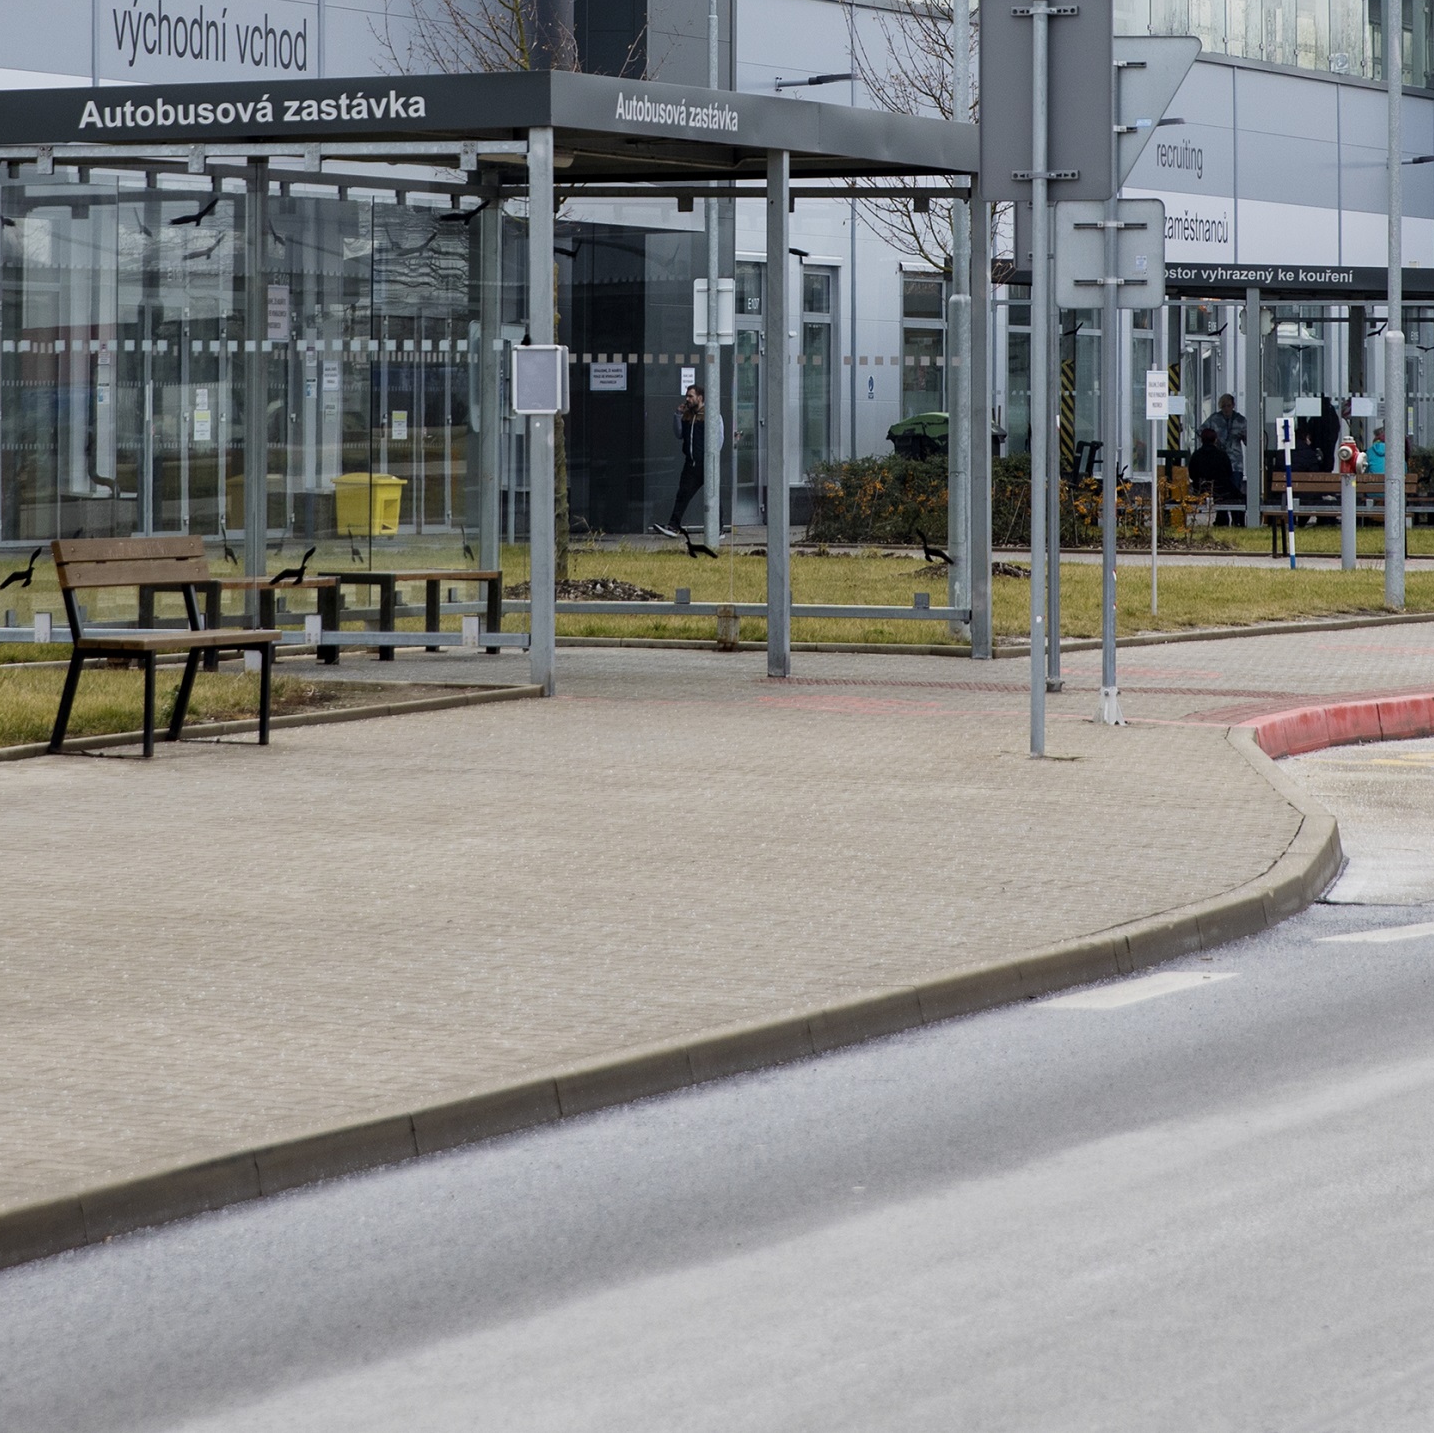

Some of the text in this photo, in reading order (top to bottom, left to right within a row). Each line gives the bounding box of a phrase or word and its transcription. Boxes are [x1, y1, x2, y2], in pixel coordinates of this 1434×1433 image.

[235, 13, 308, 72] vchod
[78, 90, 427, 129] Autobusová zastávka
[615, 91, 739, 132] Autobusová zastávka
[1156, 138, 1203, 180] recruiting
[1200, 267, 1274, 284] vyhrazený
[1277, 267, 1295, 281] ke
[1298, 268, 1354, 283] kouření
